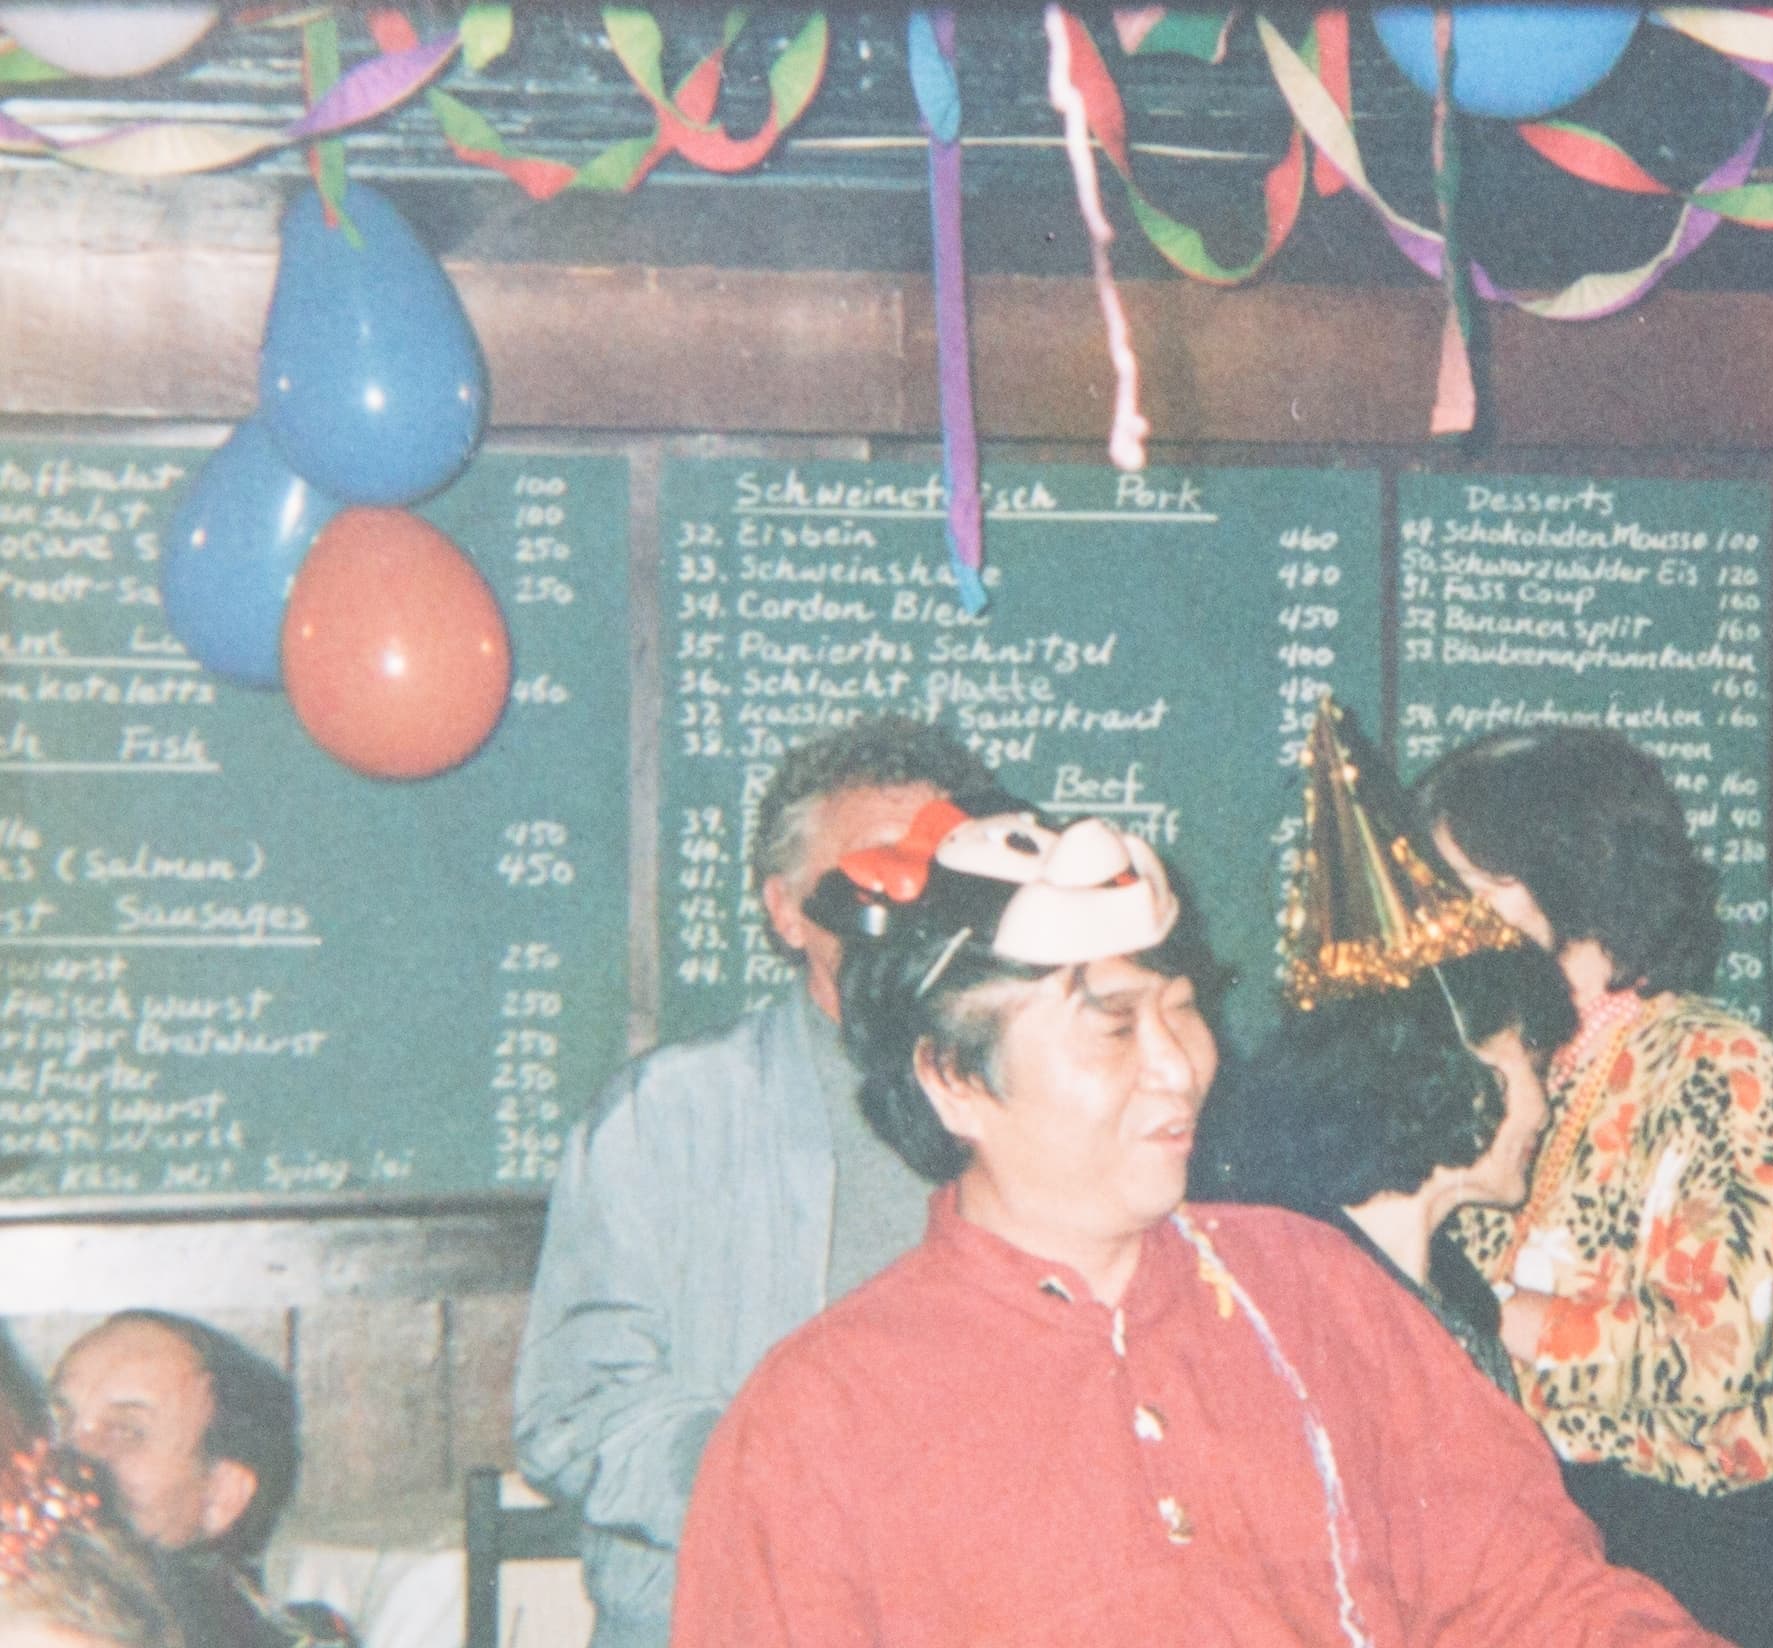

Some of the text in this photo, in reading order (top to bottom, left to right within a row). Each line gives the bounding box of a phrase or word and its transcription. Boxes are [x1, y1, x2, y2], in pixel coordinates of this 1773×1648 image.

[515, 474, 569, 497] 100
[1112, 470, 1202, 510] Pork
[1466, 481, 1614, 516] Desserts
[515, 536, 571, 563] 250
[1278, 526, 1340, 552] 460
[1714, 523, 1760, 553] 100
[737, 552, 1001, 588] Schweinshae
[1655, 557, 1700, 587] Eis
[1717, 567, 1759, 586] 120
[514, 575, 575, 604] 250
[1716, 593, 1761, 612] 160
[738, 590, 875, 623] Cordon
[1278, 604, 1340, 634] 450
[1717, 619, 1761, 642] 160
[1277, 643, 1336, 668] 400
[740, 664, 912, 699] Schlacht
[957, 697, 1170, 731] Sauerkraut
[118, 722, 210, 764] Fish
[1050, 761, 1145, 806] Beef
[505, 820, 569, 848] 450
[498, 851, 576, 886] 450
[116, 895, 310, 940] Sausages
[502, 943, 561, 971] 250
[492, 1062, 558, 1090] 250
